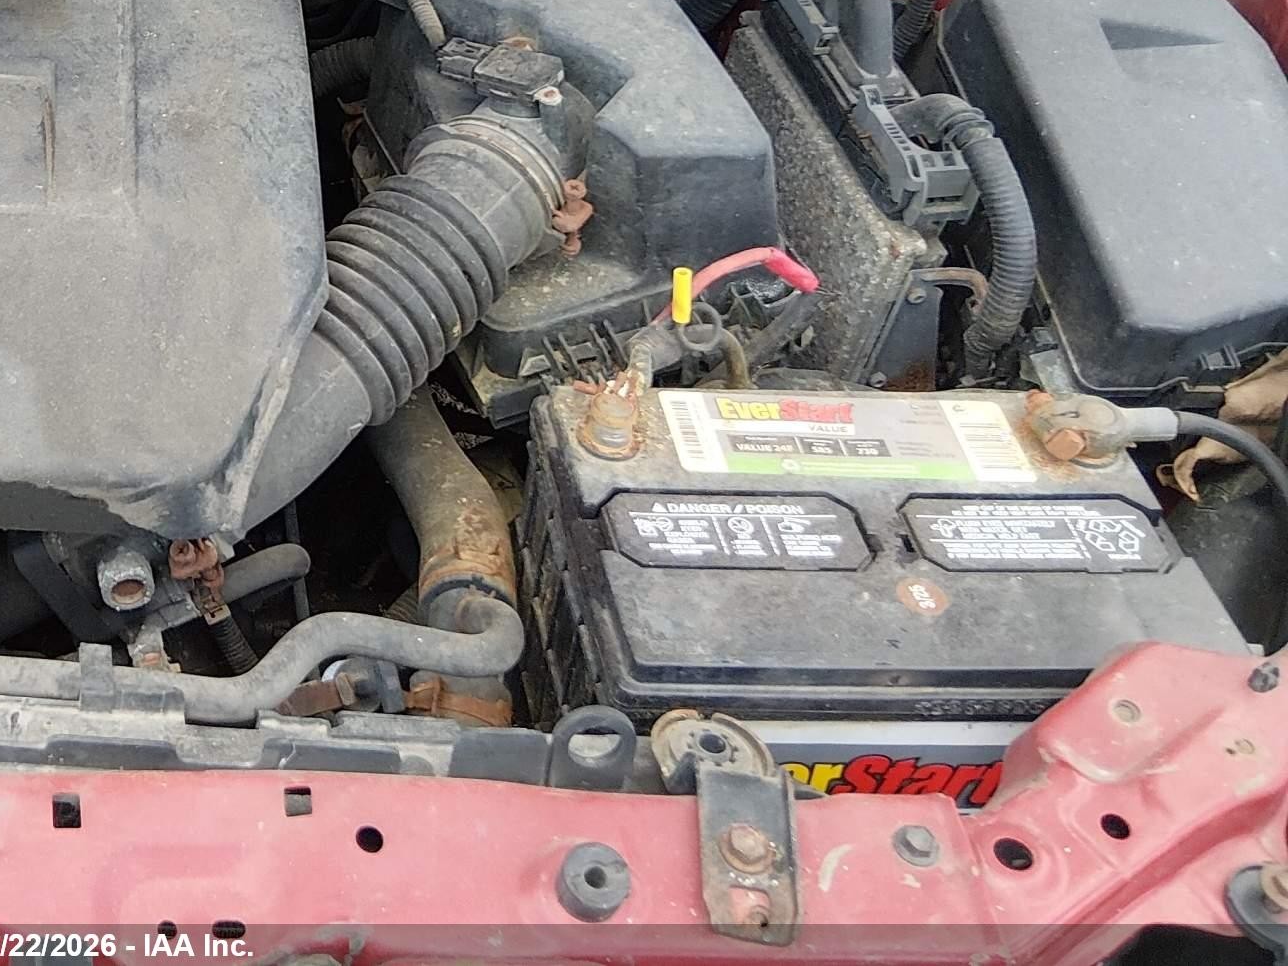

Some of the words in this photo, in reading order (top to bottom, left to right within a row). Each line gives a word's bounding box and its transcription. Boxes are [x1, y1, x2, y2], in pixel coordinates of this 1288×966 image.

[715, 397, 853, 423] EverStart
[809, 424, 848, 434] VALUE
[736, 442, 772, 452] VALUE
[667, 503, 732, 513] DANGER
[747, 504, 804, 514] POISON
